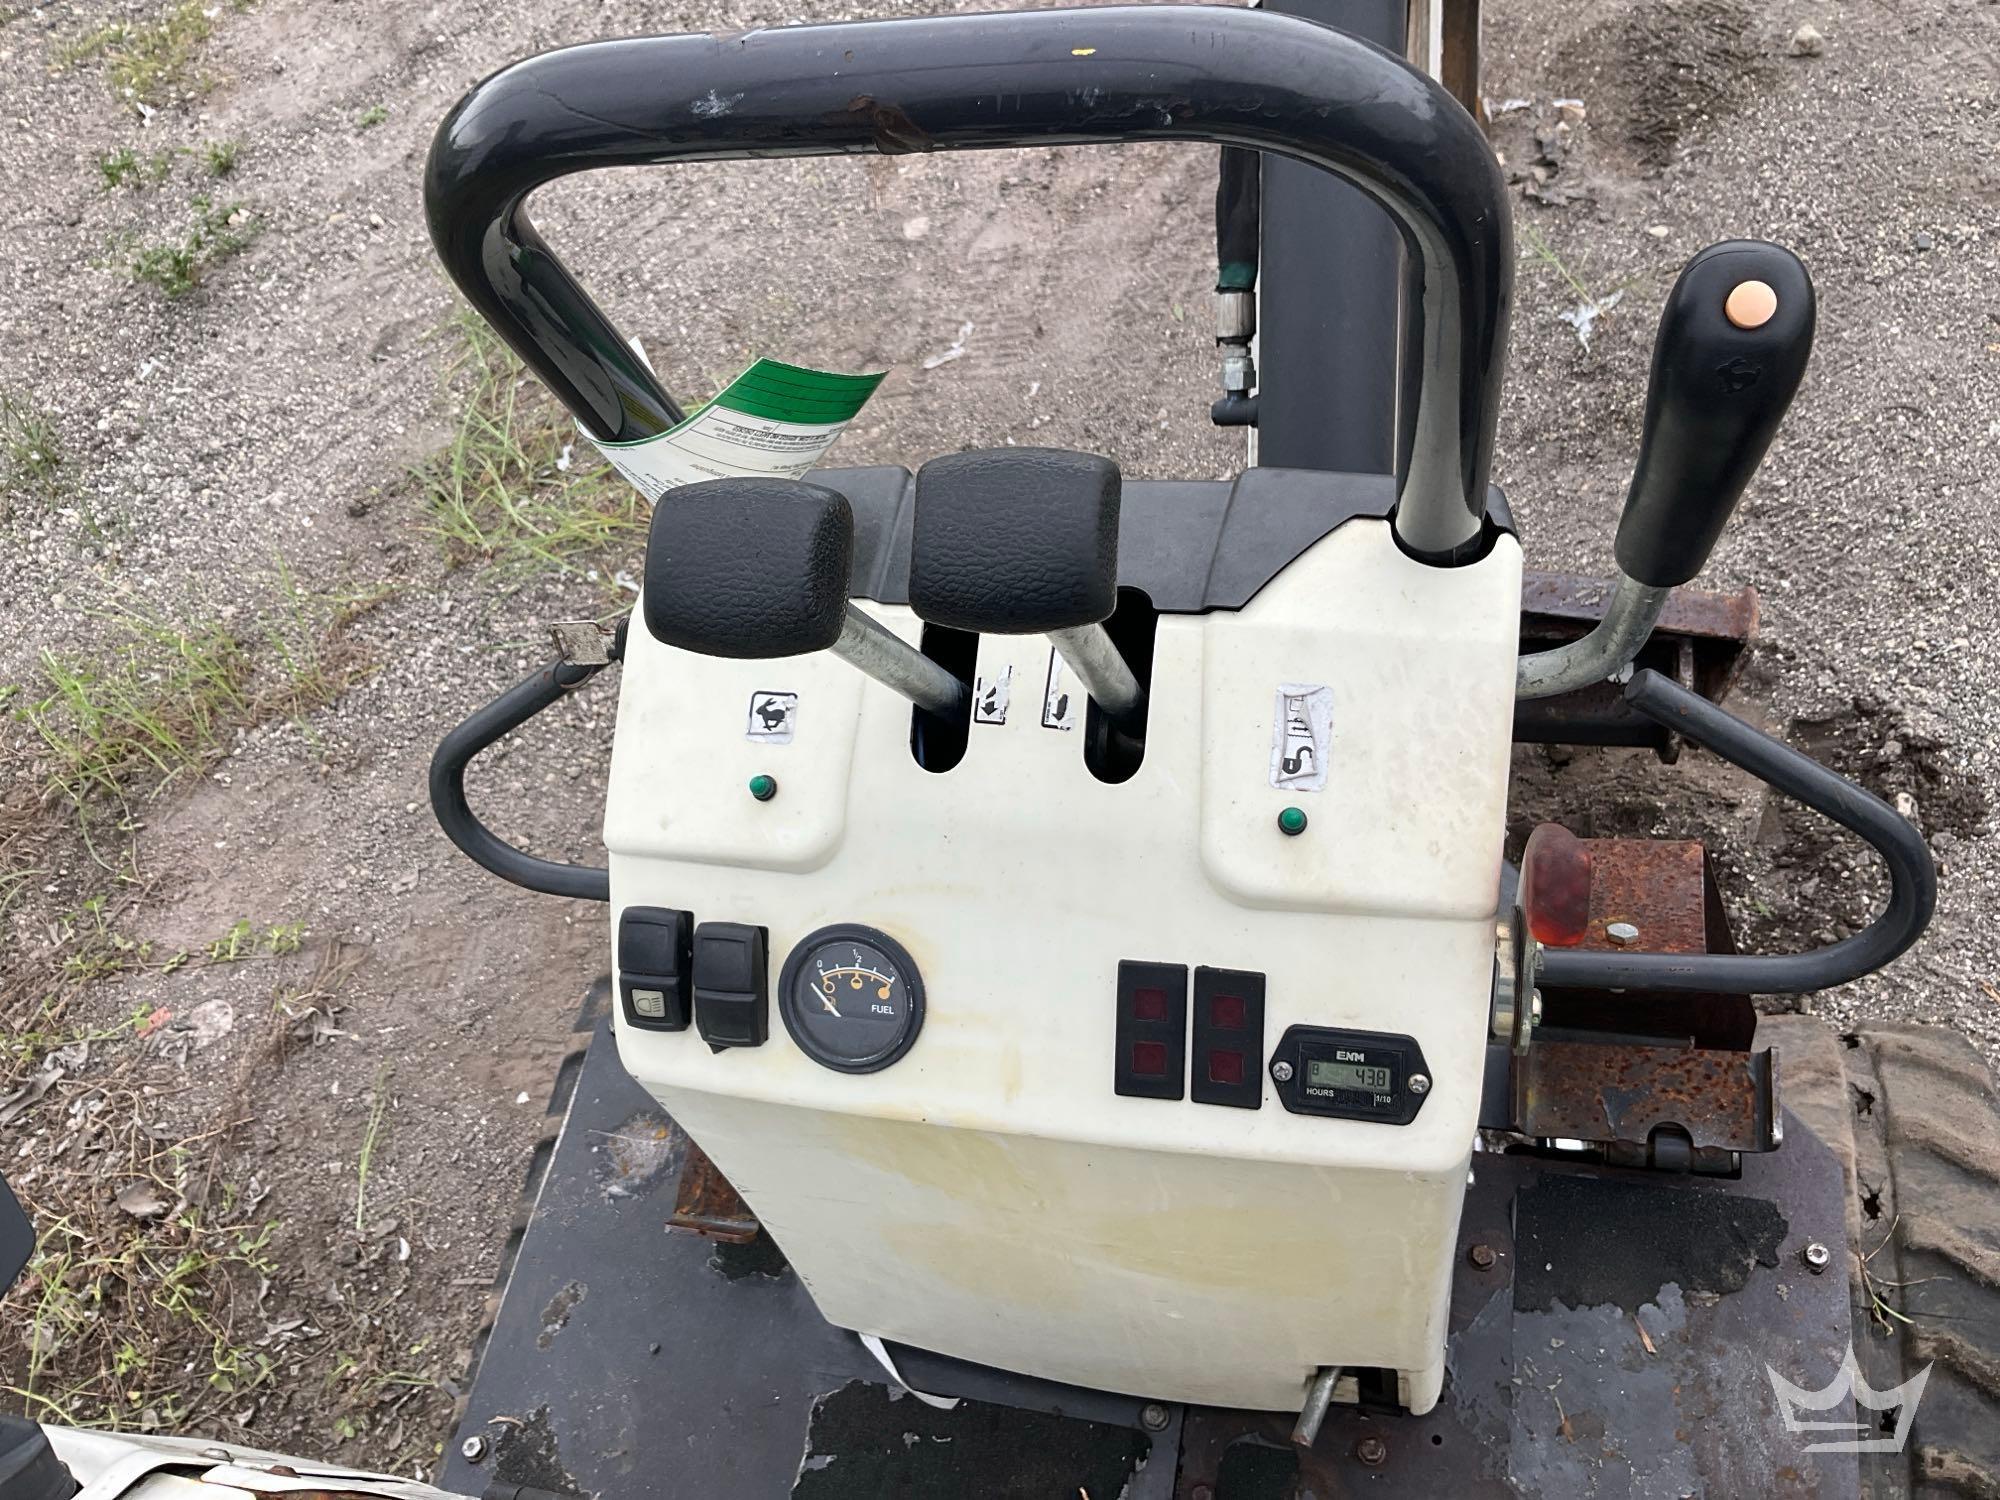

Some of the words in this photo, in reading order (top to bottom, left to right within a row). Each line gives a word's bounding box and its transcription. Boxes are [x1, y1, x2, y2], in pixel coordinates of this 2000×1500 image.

[872, 1004, 894, 1014] FUEL
[1336, 1050, 1365, 1062] ENM
[1306, 1088, 1334, 1097] HOURS
[1376, 1094, 1392, 1103] 1/10
